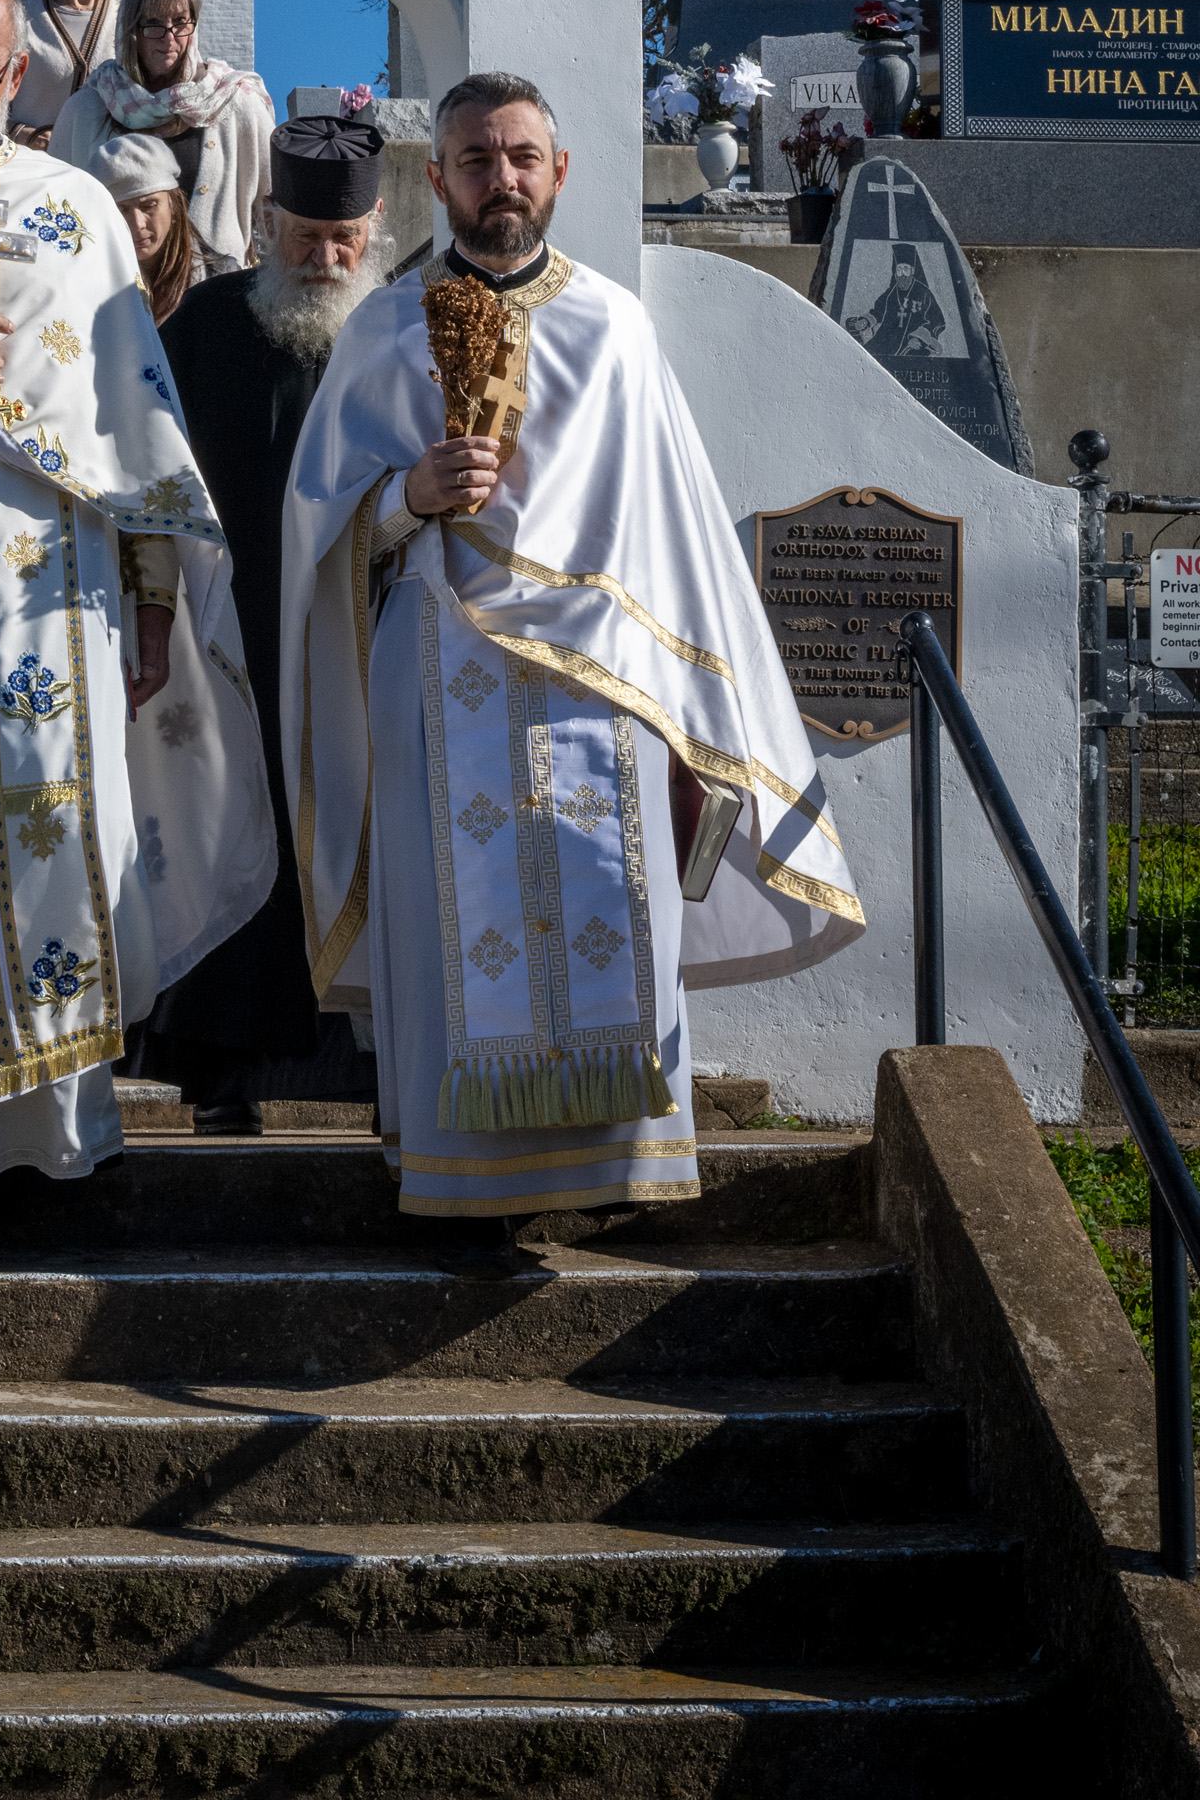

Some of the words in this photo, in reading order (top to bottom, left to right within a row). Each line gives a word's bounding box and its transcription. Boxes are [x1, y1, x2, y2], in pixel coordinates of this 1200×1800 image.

[990, 5, 1185, 39] МИЛАДИН
[1052, 50, 1085, 59] ПАРОХ
[1095, 50, 1159, 60] САКРАМЕНТУ
[1166, 52, 1187, 60] ФЕР
[1046, 67, 1148, 95] НИНА
[1157, 69, 1200, 96] ГА
[803, 83, 862, 104] VUKA
[1118, 99, 1199, 113] ПРОТИНИЦА
[946, 423, 1001, 436] TRATOR
[817, 524, 855, 538] SAVA
[858, 525, 928, 541] SERBIAN
[776, 542, 869, 558] ORTHODOX
[878, 545, 946, 561] CHURCH
[894, 570, 916, 582] ON
[1160, 580, 1200, 594] Priva
[763, 587, 857, 605] NATIONAL
[866, 591, 956, 608] REGISTER
[1162, 599, 1175, 608] All
[847, 617, 870, 633] OF
[778, 642, 859, 659] HISTORIC
[788, 666, 803, 677] BY
[836, 667, 882, 679] UNITED
